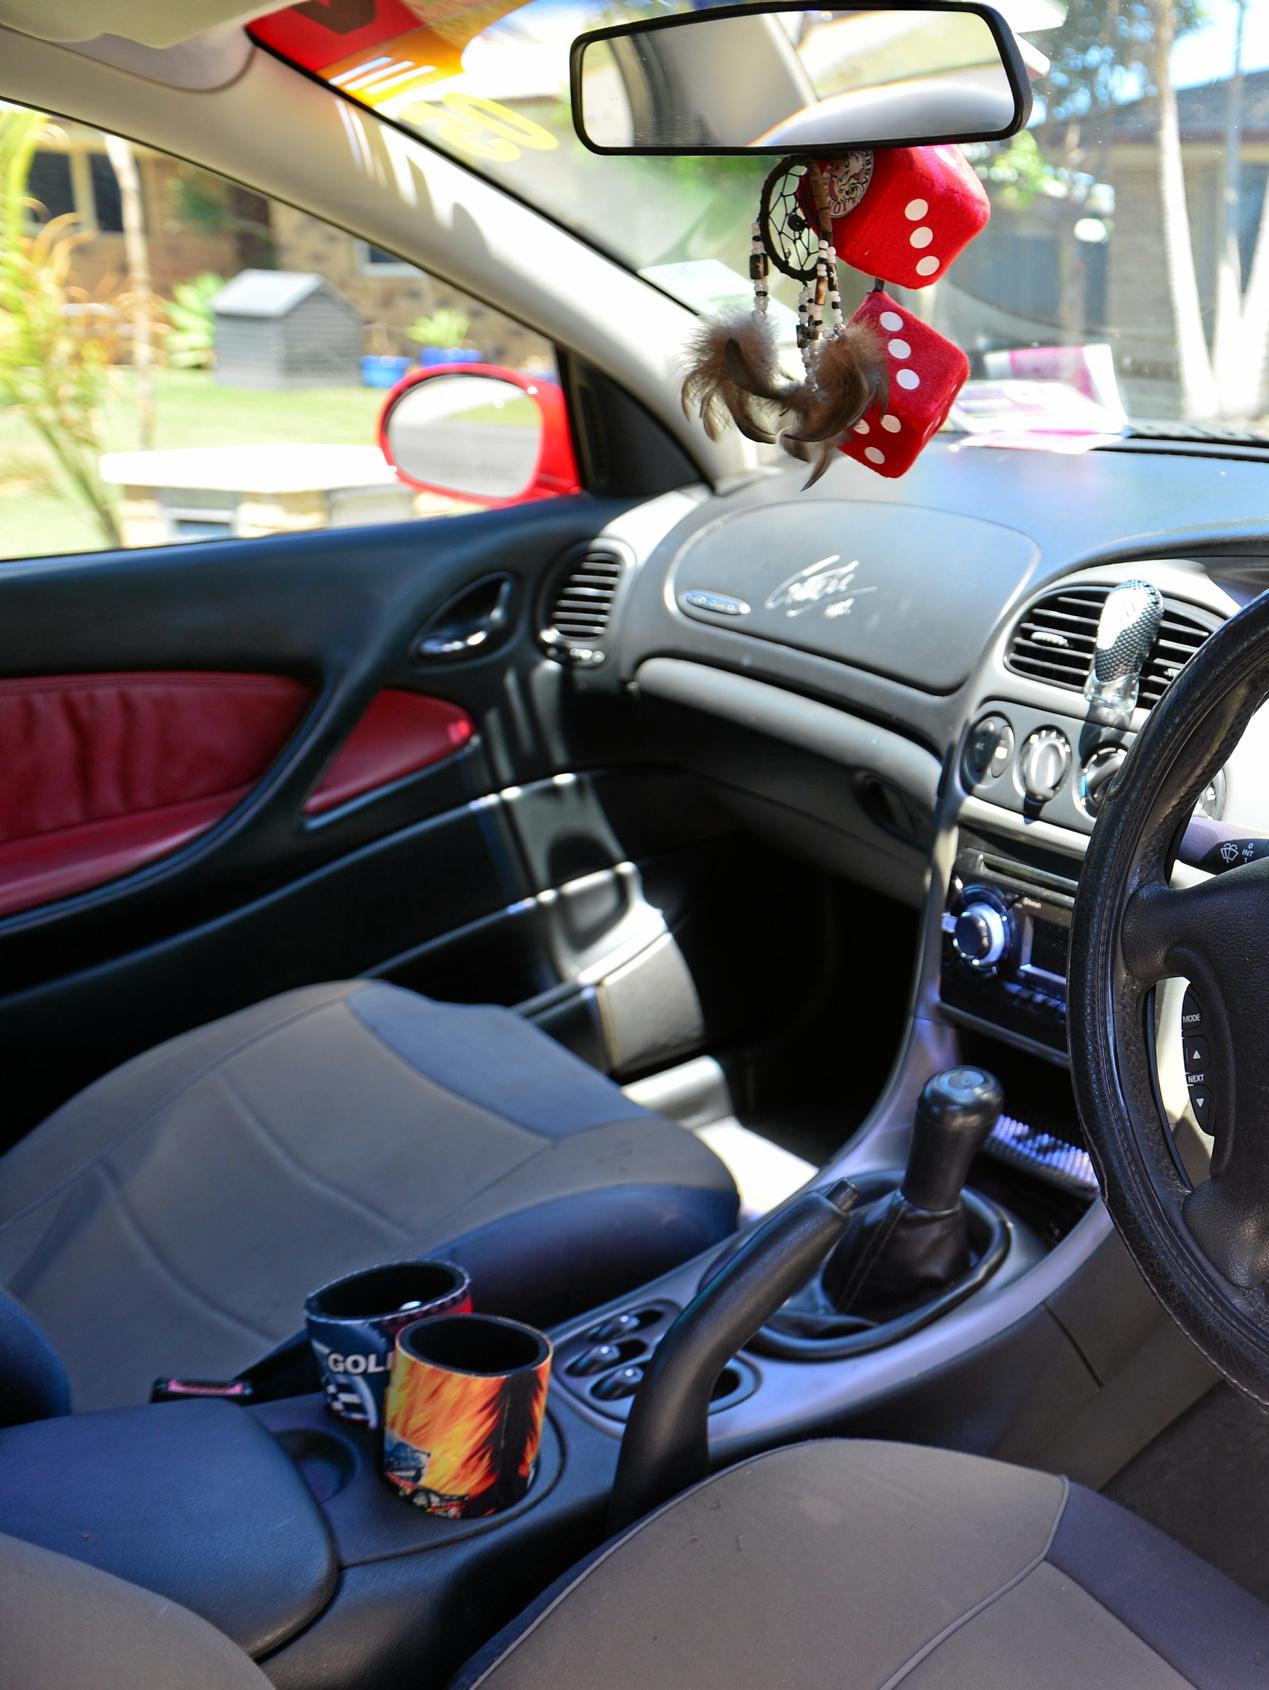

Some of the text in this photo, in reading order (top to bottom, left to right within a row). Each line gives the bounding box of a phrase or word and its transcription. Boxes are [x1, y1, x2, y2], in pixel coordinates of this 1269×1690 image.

[1241, 849, 1254, 857] INT
[1182, 1014, 1201, 1023] MODE
[1187, 1074, 1205, 1083] NEXT
